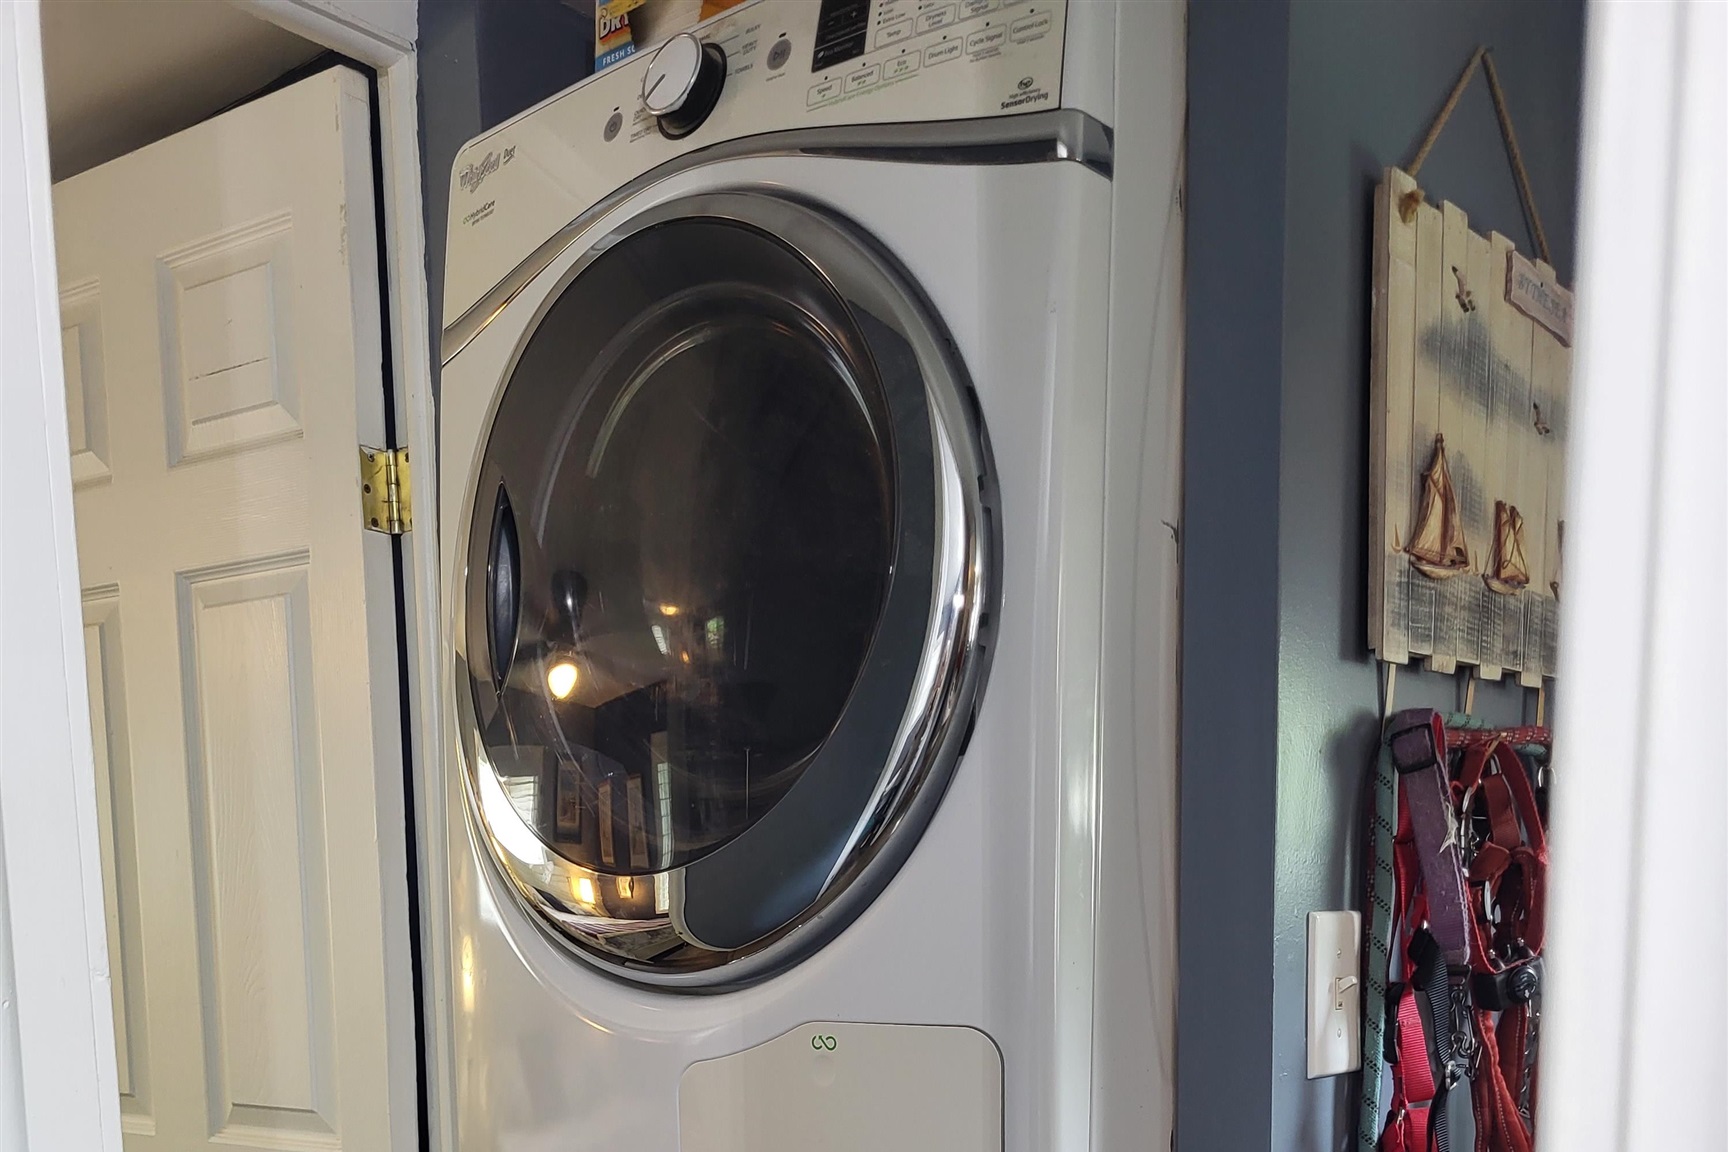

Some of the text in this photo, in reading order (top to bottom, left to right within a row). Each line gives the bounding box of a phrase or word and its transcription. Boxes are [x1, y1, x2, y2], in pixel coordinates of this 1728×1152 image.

[1012, 18, 1049, 34] Control Lock
[969, 32, 1003, 47] Cycle Signal
[602, 49, 625, 67] FRESH
[928, 50, 944, 60] Drum
[944, 44, 959, 55] Light
[851, 70, 874, 83] Balanced
[816, 84, 833, 96] Speed
[1001, 92, 1049, 110] SensorDrying
